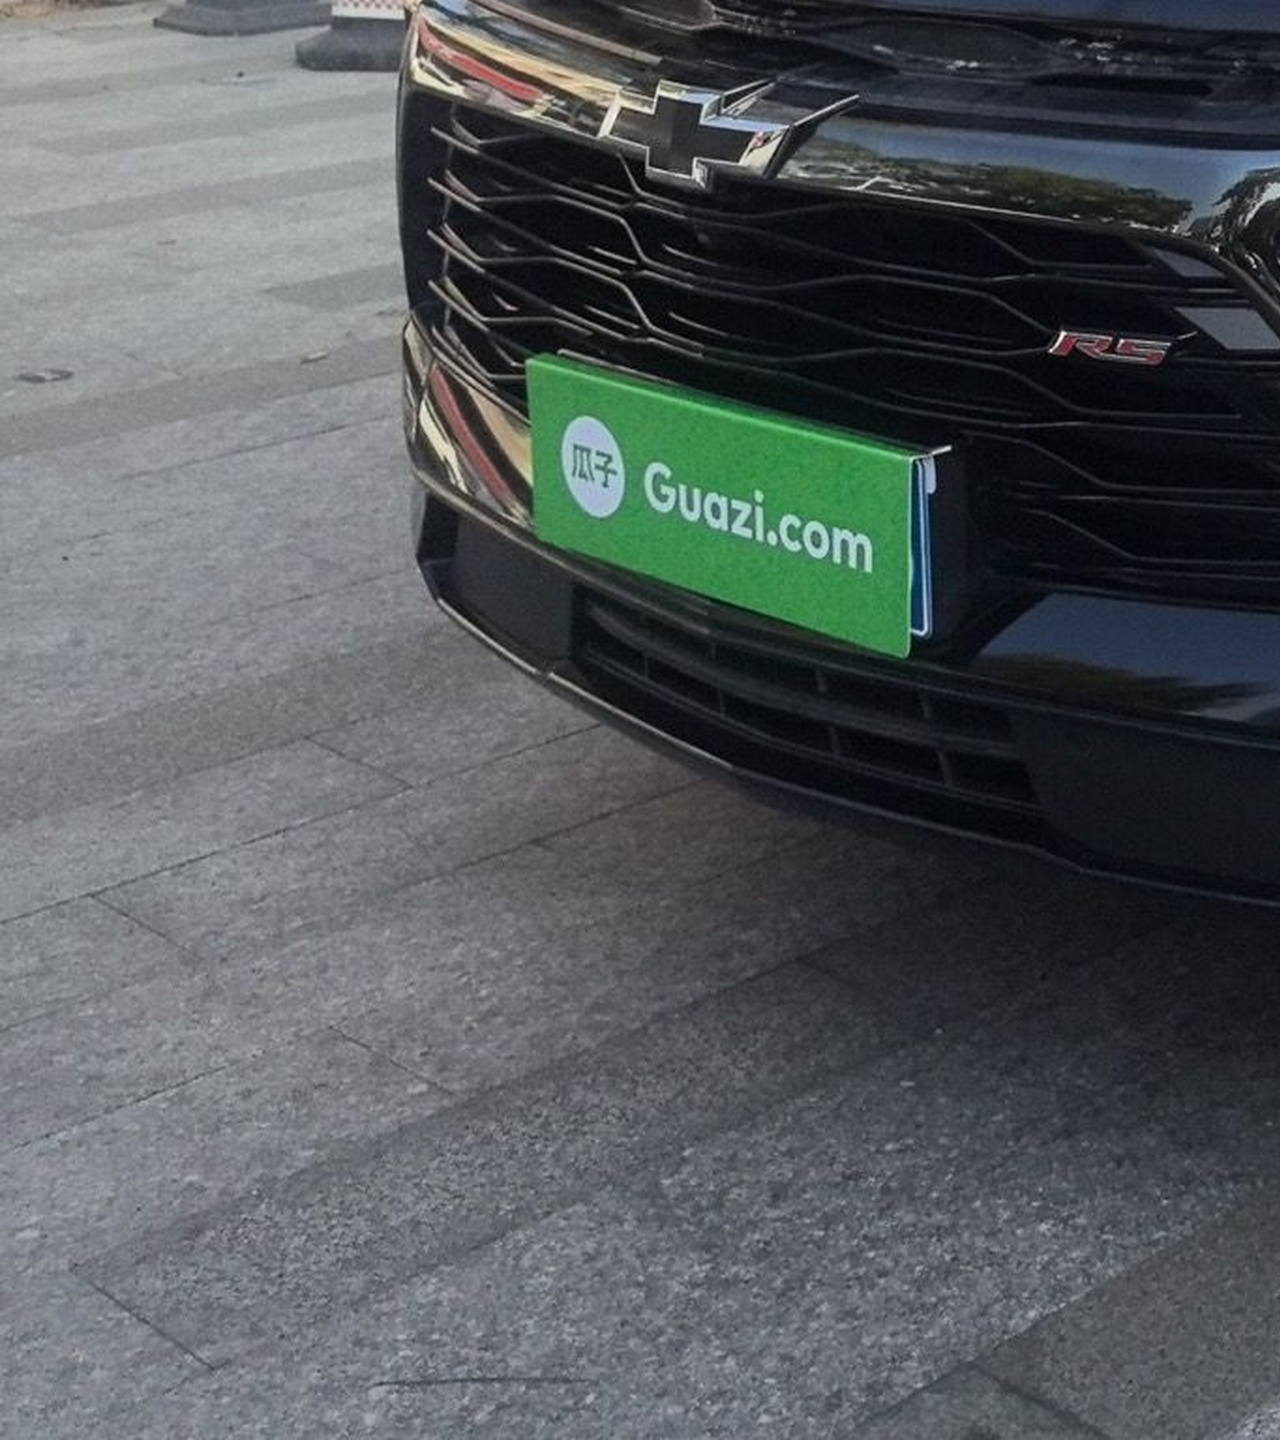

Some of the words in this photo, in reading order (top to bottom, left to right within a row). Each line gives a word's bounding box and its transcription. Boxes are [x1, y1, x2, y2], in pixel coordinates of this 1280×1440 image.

[1048, 329, 1172, 366] RS
[571, 443, 618, 489] 瓜子
[643, 461, 874, 574] Guazi.com
